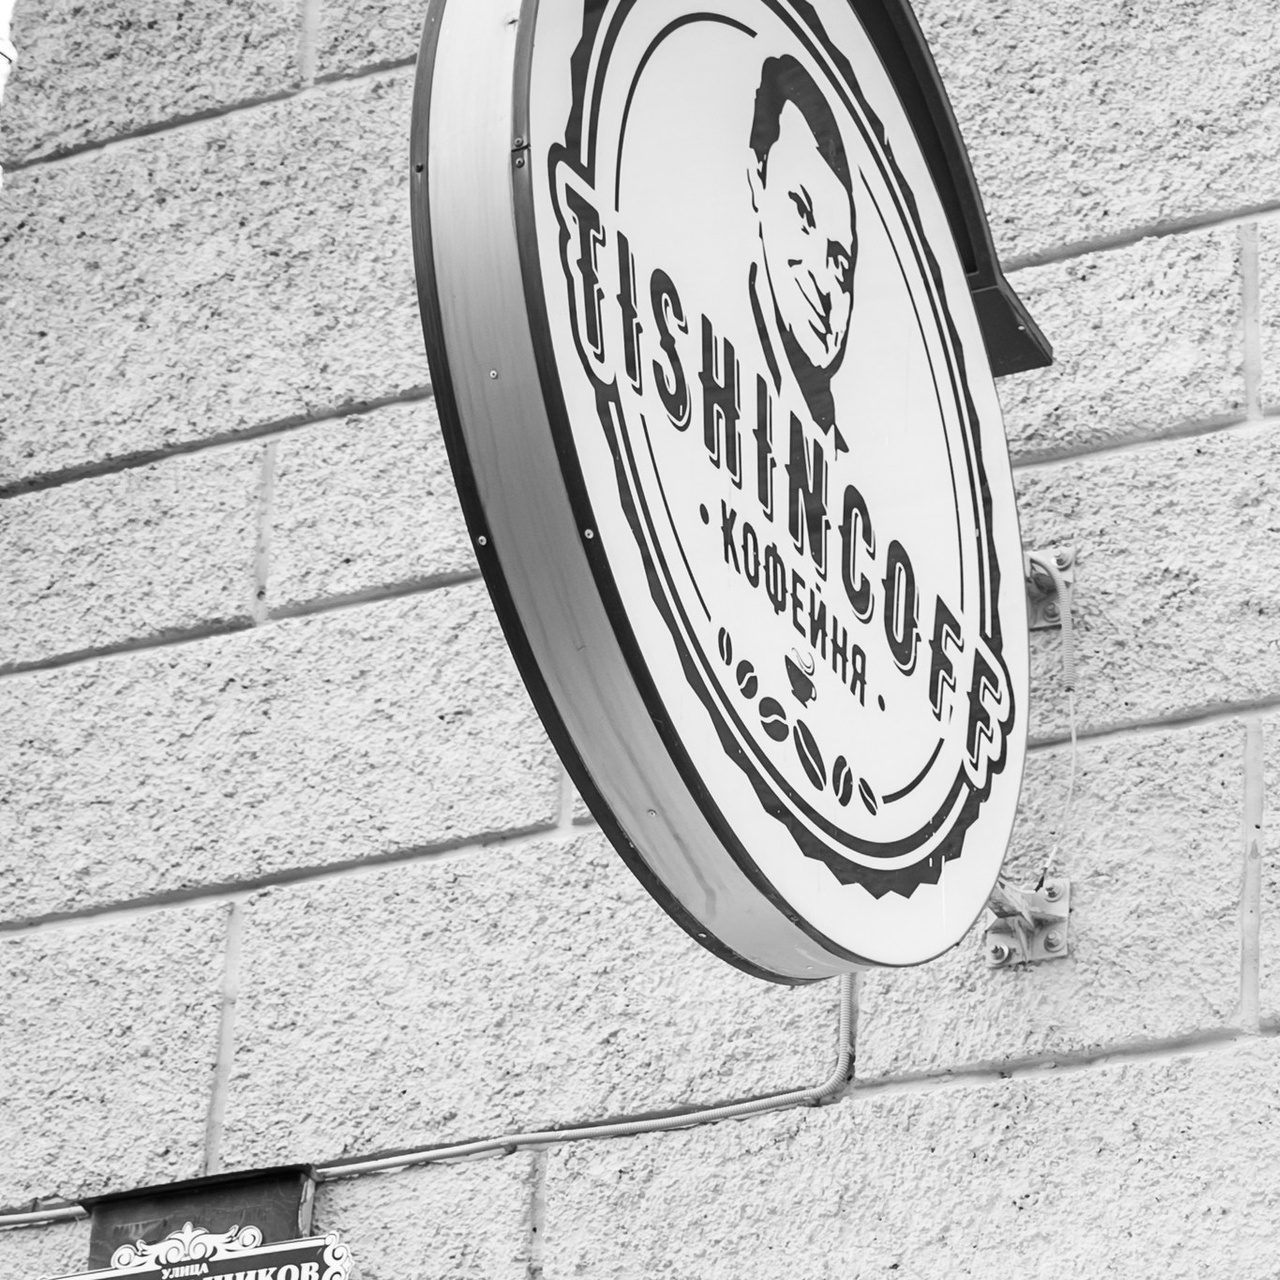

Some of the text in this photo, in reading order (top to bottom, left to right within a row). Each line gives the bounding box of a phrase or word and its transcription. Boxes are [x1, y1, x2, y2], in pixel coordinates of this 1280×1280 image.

[564, 182, 1002, 772] TISHINCOFF
[720, 499, 867, 708] КОФЕЙНЯ
[161, 1262, 209, 1280] УЛИЦА
